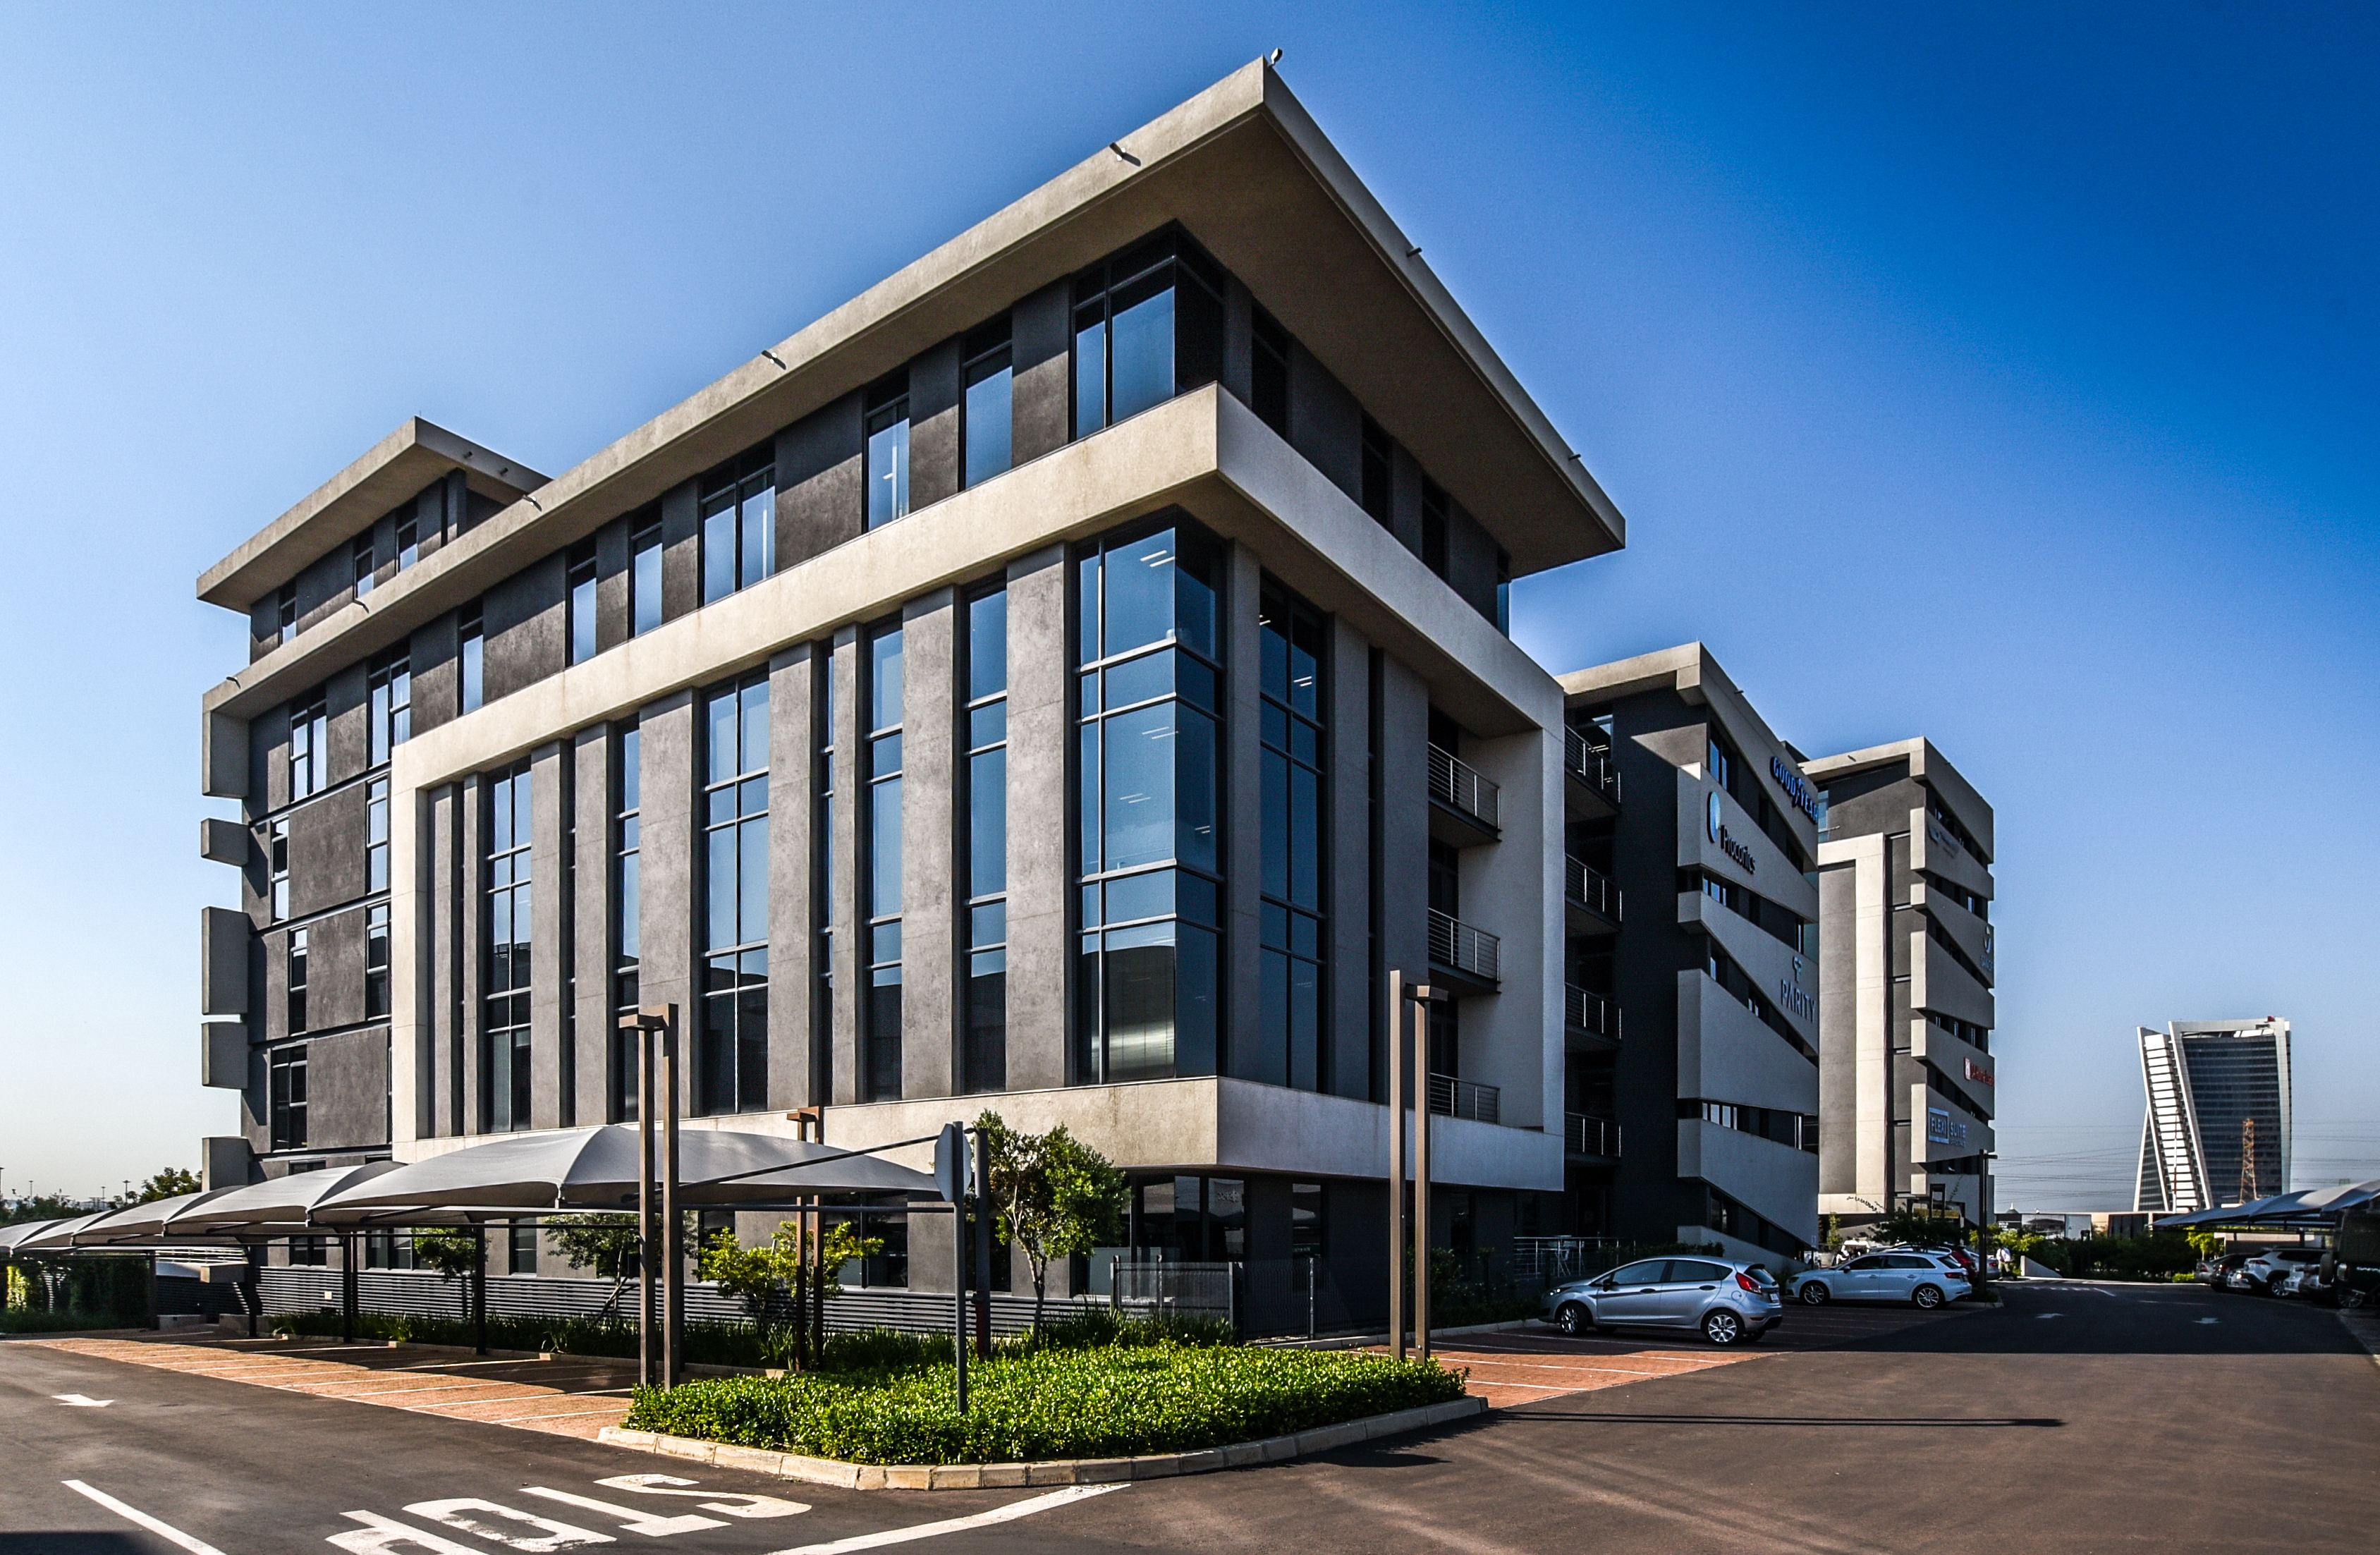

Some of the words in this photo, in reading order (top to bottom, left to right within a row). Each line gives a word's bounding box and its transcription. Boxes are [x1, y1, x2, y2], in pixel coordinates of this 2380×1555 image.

[1770, 756, 1819, 824] GOODYEAR
[1721, 824, 1755, 874] Proconics
[1781, 979, 1815, 1023] PARITY
[1930, 1117, 1946, 1135] FLEXI
[1949, 1122, 1966, 1139] SUITE
[324, 1473, 812, 1555] STOP
